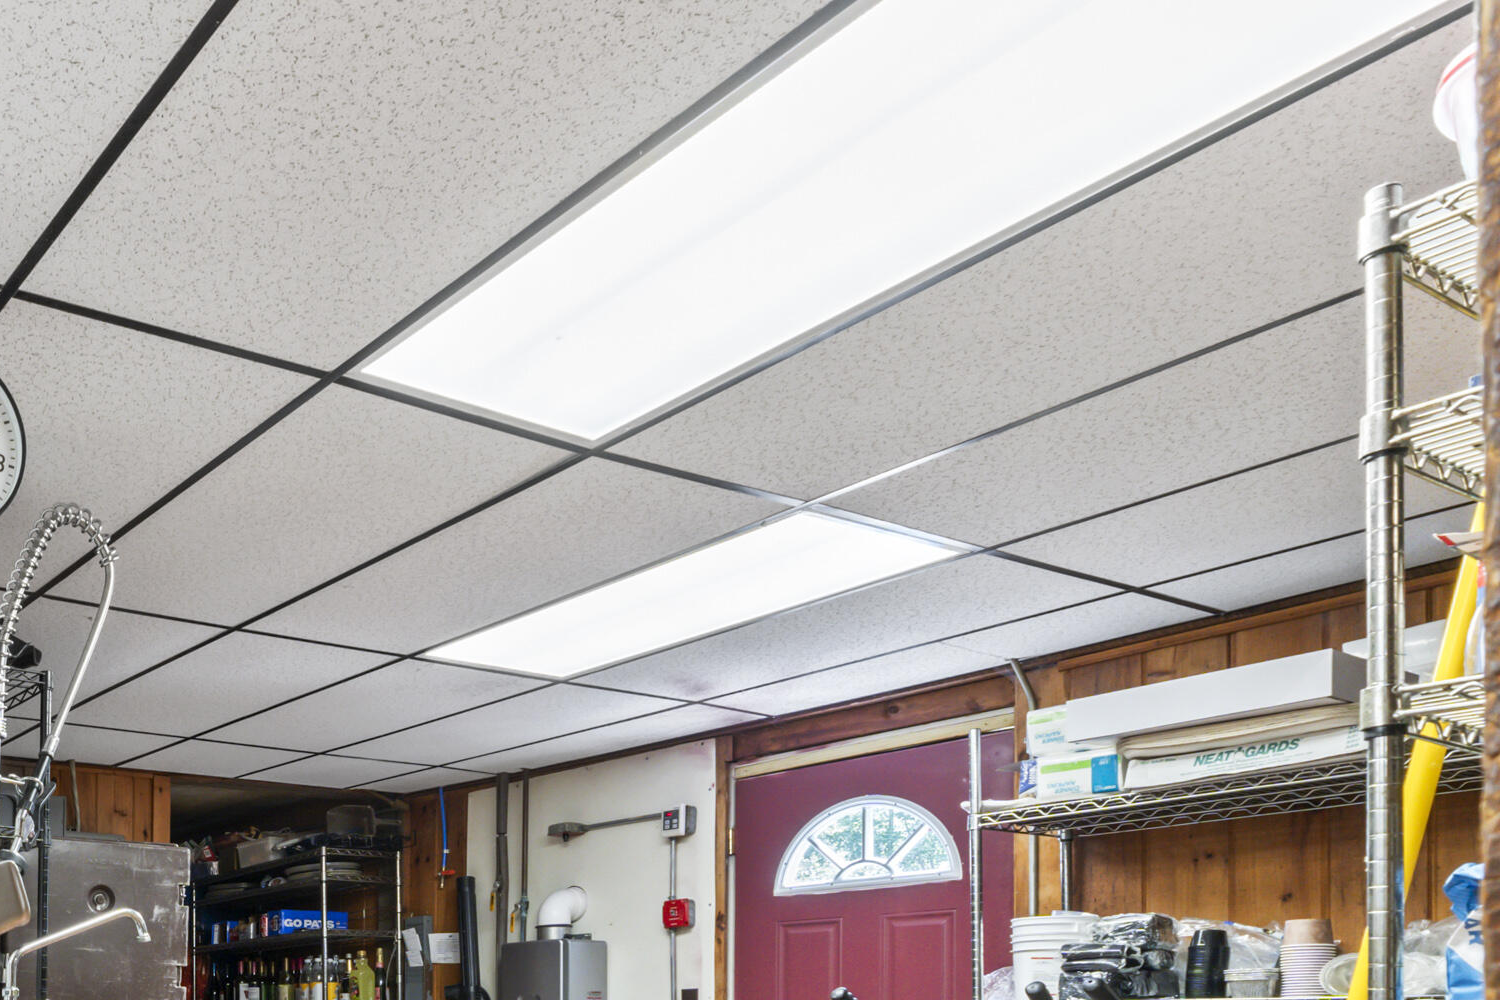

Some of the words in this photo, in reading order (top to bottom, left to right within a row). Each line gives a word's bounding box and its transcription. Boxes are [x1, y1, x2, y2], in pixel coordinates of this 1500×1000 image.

[1193, 750, 1235, 766] NEAT
[1244, 738, 1301, 758] GARDS
[284, 918, 302, 928] GO
